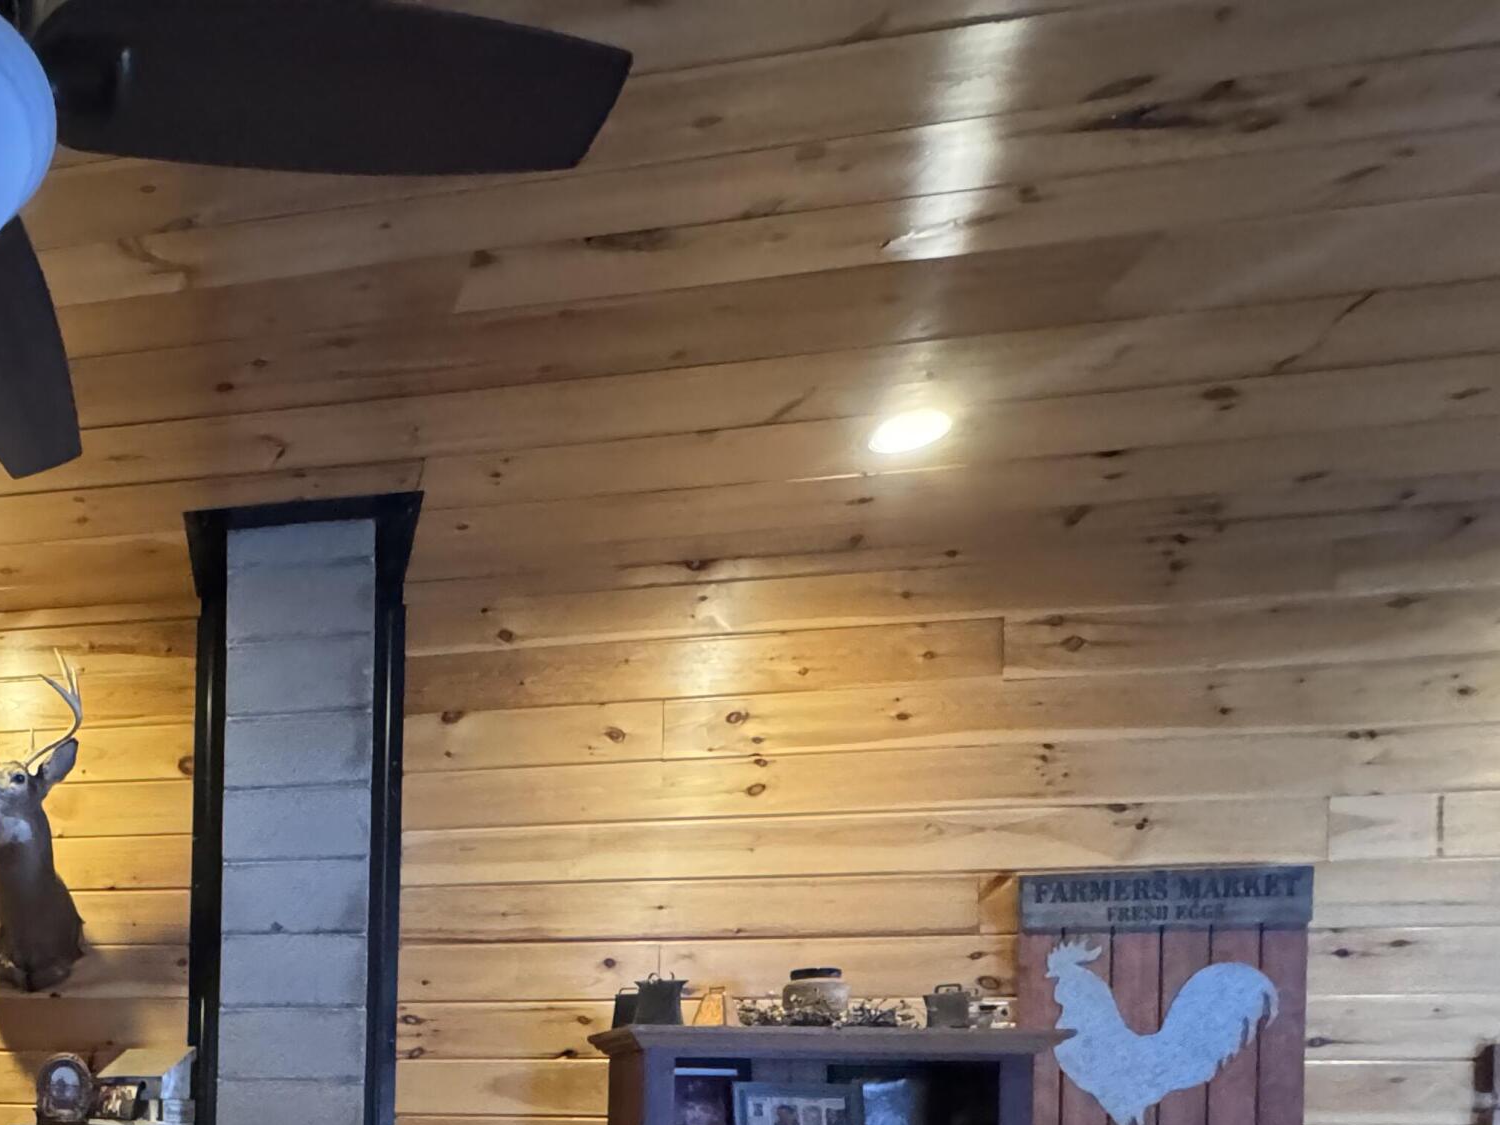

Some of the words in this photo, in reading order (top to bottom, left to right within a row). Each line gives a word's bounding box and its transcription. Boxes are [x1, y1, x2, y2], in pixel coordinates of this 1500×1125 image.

[1034, 878, 1169, 904] FARMERS
[1179, 872, 1301, 900] MARKET
[1107, 905, 1169, 922] FRESH
[1176, 903, 1225, 921] EGGS
